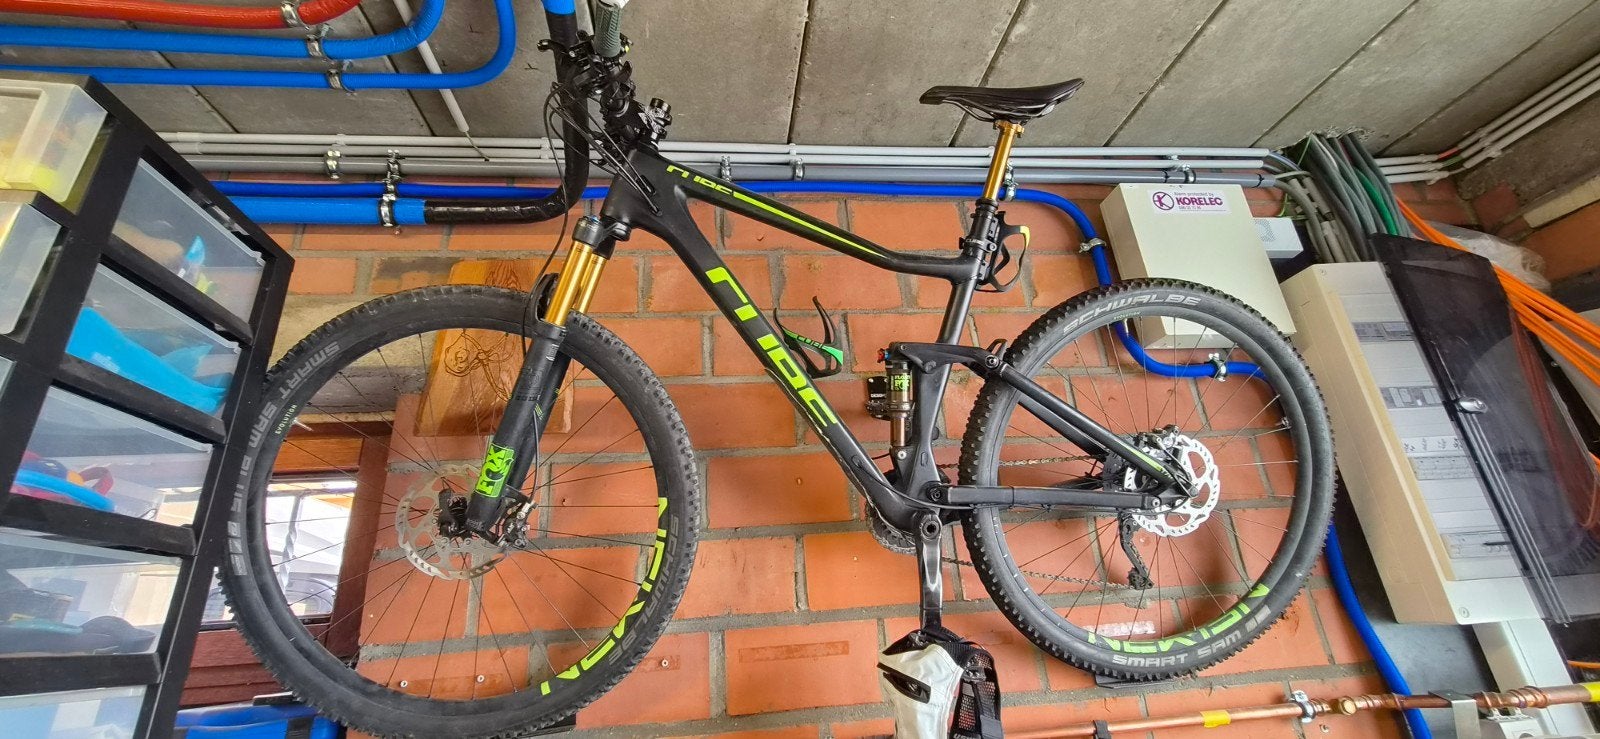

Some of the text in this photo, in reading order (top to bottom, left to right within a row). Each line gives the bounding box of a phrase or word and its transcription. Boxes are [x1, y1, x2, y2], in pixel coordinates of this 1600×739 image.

[1175, 197, 1223, 206] KORELEC
[1063, 294, 1202, 335] SCHWALBE
[281, 341, 340, 400] SMART
[248, 401, 277, 448] SAM
[274, 404, 297, 435] EVOLUTION
[475, 443, 514, 496] FOX
[608, 514, 679, 666] SCHWALBE
[1112, 632, 1243, 668] SMART SAM
